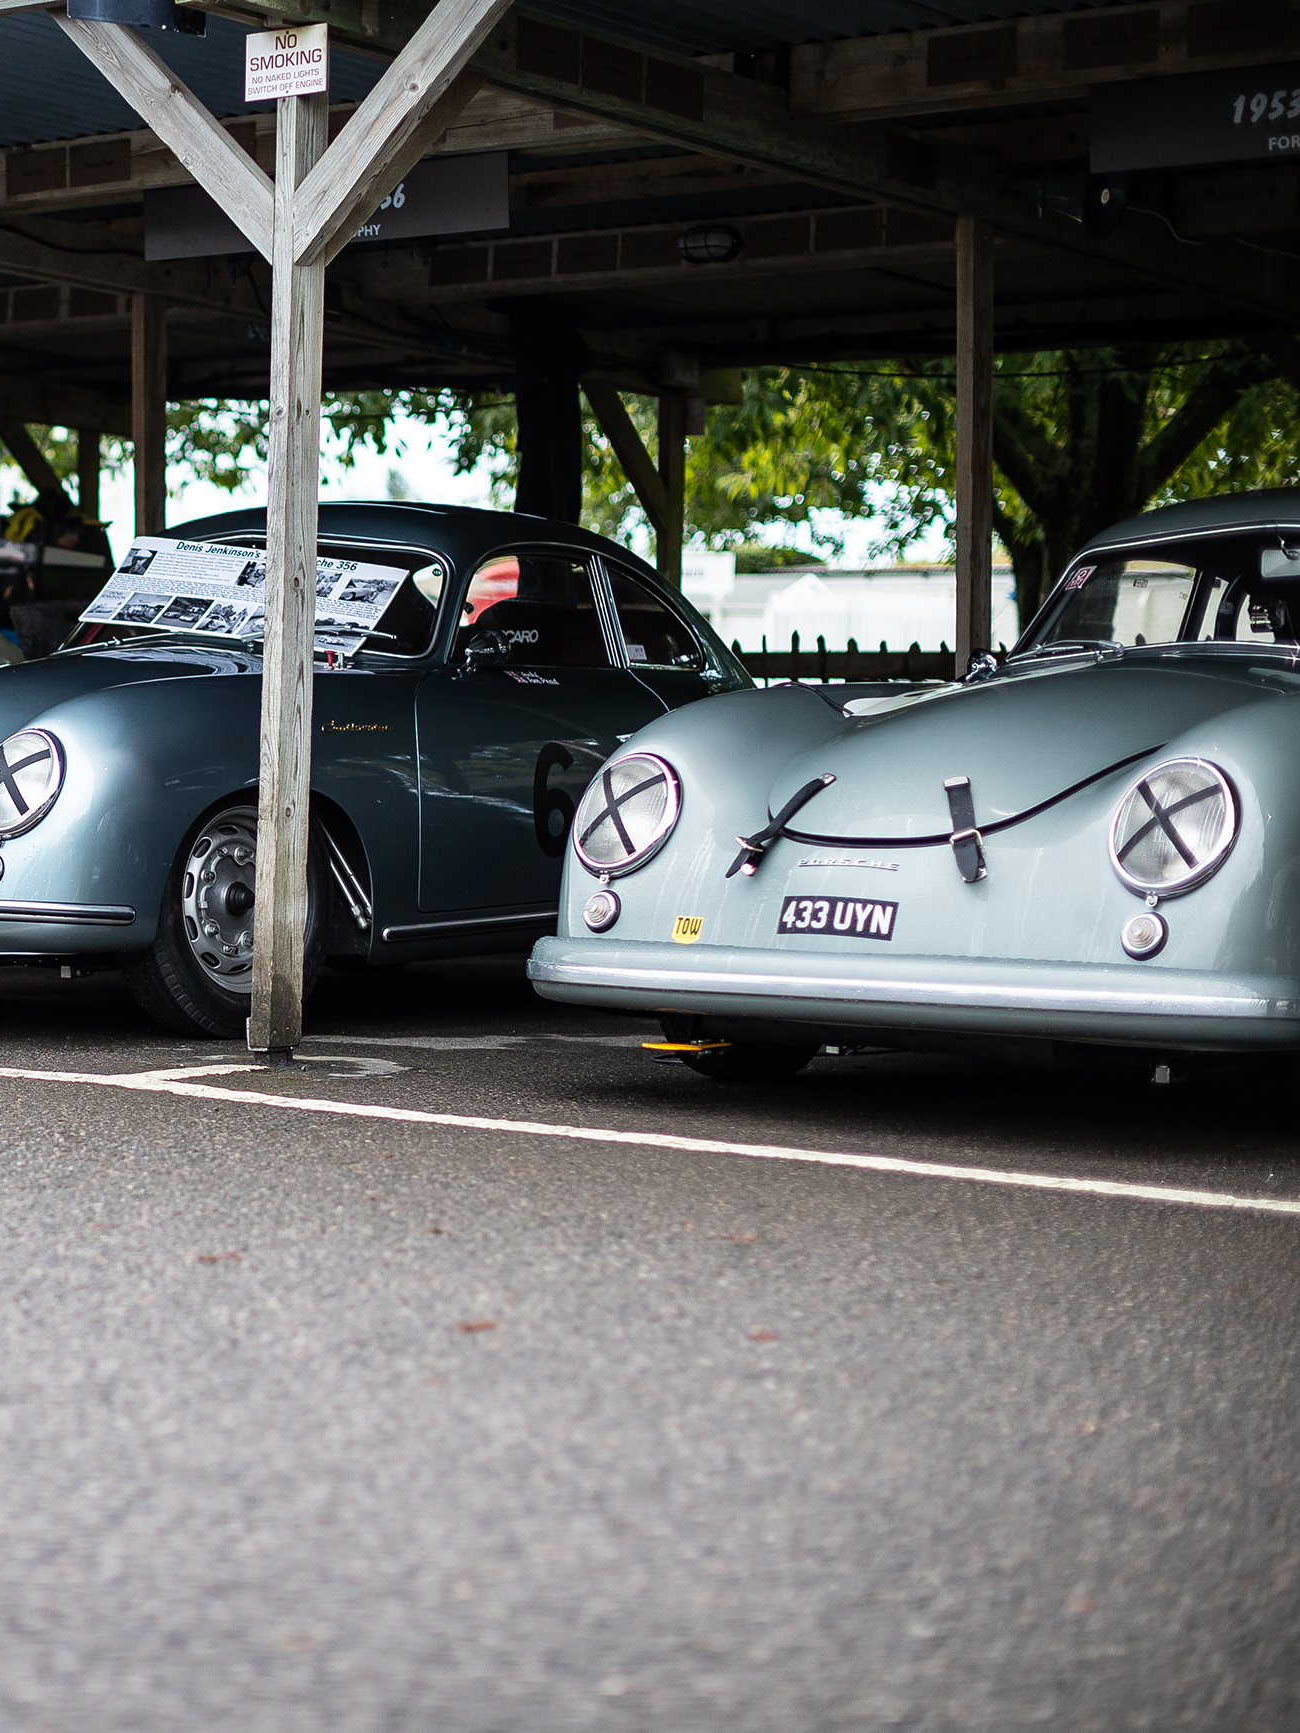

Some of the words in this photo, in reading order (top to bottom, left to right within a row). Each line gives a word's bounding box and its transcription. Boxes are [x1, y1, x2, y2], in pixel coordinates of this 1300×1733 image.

[275, 34, 298, 51] NO
[250, 48, 322, 72] SMOKING
[252, 75, 264, 84] NO
[265, 72, 292, 83] NAKED
[293, 68, 320, 79] LIGHTS
[247, 85, 278, 96] SWITCH
[279, 82, 294, 92] OFF
[295, 78, 324, 90] ENGINE
[176, 541, 203, 553] Denis
[204, 545, 262, 559] Jenkinson's
[336, 561, 359, 571] 356
[534, 742, 576, 858] 6
[798, 858, 900, 870] PORSCHE
[676, 917, 703, 935] TOW
[782, 900, 828, 929] 433
[833, 902, 894, 935] UYN
